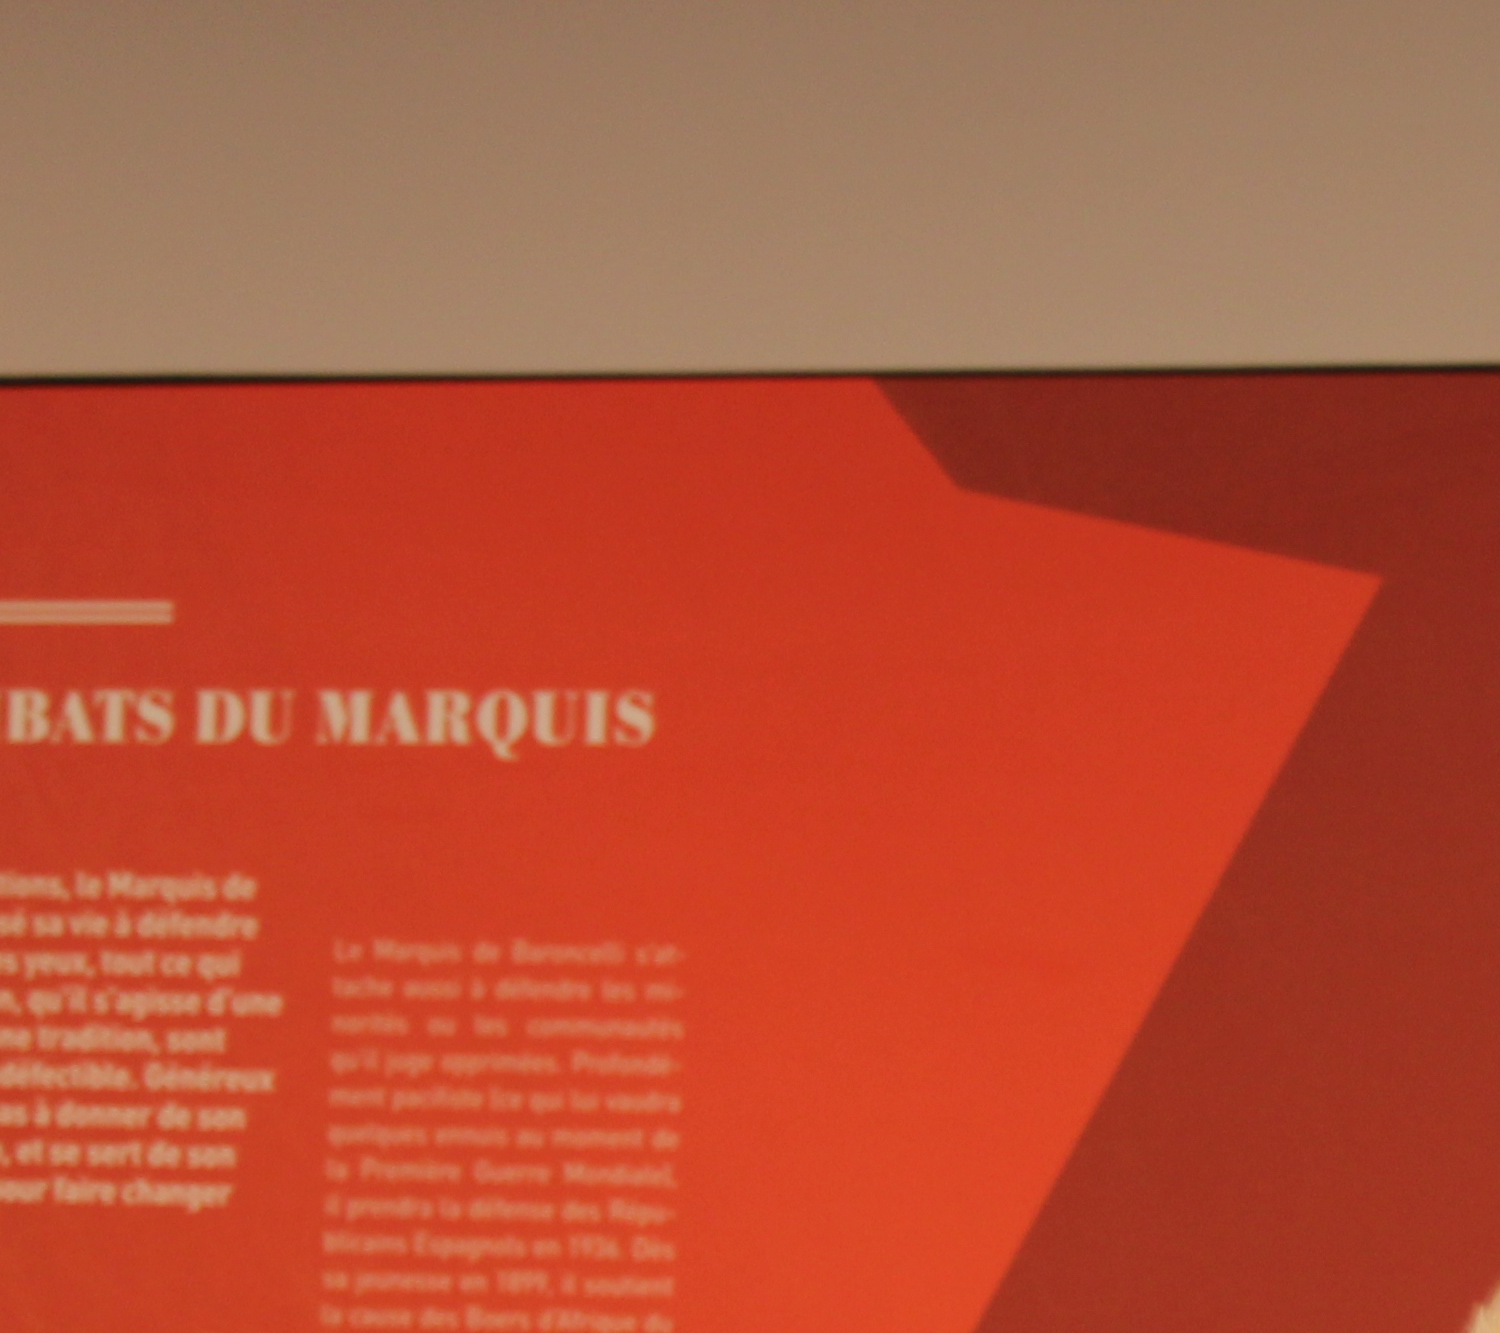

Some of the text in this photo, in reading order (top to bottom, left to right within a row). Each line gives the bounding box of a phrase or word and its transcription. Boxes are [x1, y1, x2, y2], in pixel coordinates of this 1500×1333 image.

[194, 690, 293, 744] DU
[316, 690, 655, 758] MARQUIS
[74, 872, 102, 898] le
[106, 872, 217, 902] Marquis
[221, 873, 257, 900] de
[31, 914, 65, 936] sa
[67, 913, 110, 937] vie
[113, 910, 132, 937] à
[134, 911, 259, 938] défendre
[99, 951, 156, 975] tout
[158, 954, 193, 976] ce
[195, 952, 242, 981] qui
[26, 985, 88, 1018] qu'il
[92, 988, 202, 1019] s'agisse
[205, 987, 283, 1015] d'une
[166, 1028, 226, 1052] sont
[142, 1062, 275, 1092] Généreux
[32, 1099, 51, 1126] à
[54, 1101, 151, 1128] donner
[155, 1102, 192, 1129] de
[196, 1108, 247, 1130] son
[14, 1139, 45, 1163] et
[47, 1143, 81, 1165] se
[85, 1142, 143, 1165] sert
[145, 1141, 182, 1167] de
[185, 1146, 237, 1168] son
[51, 1176, 117, 1204] faire
[120, 1179, 231, 1212] changer
